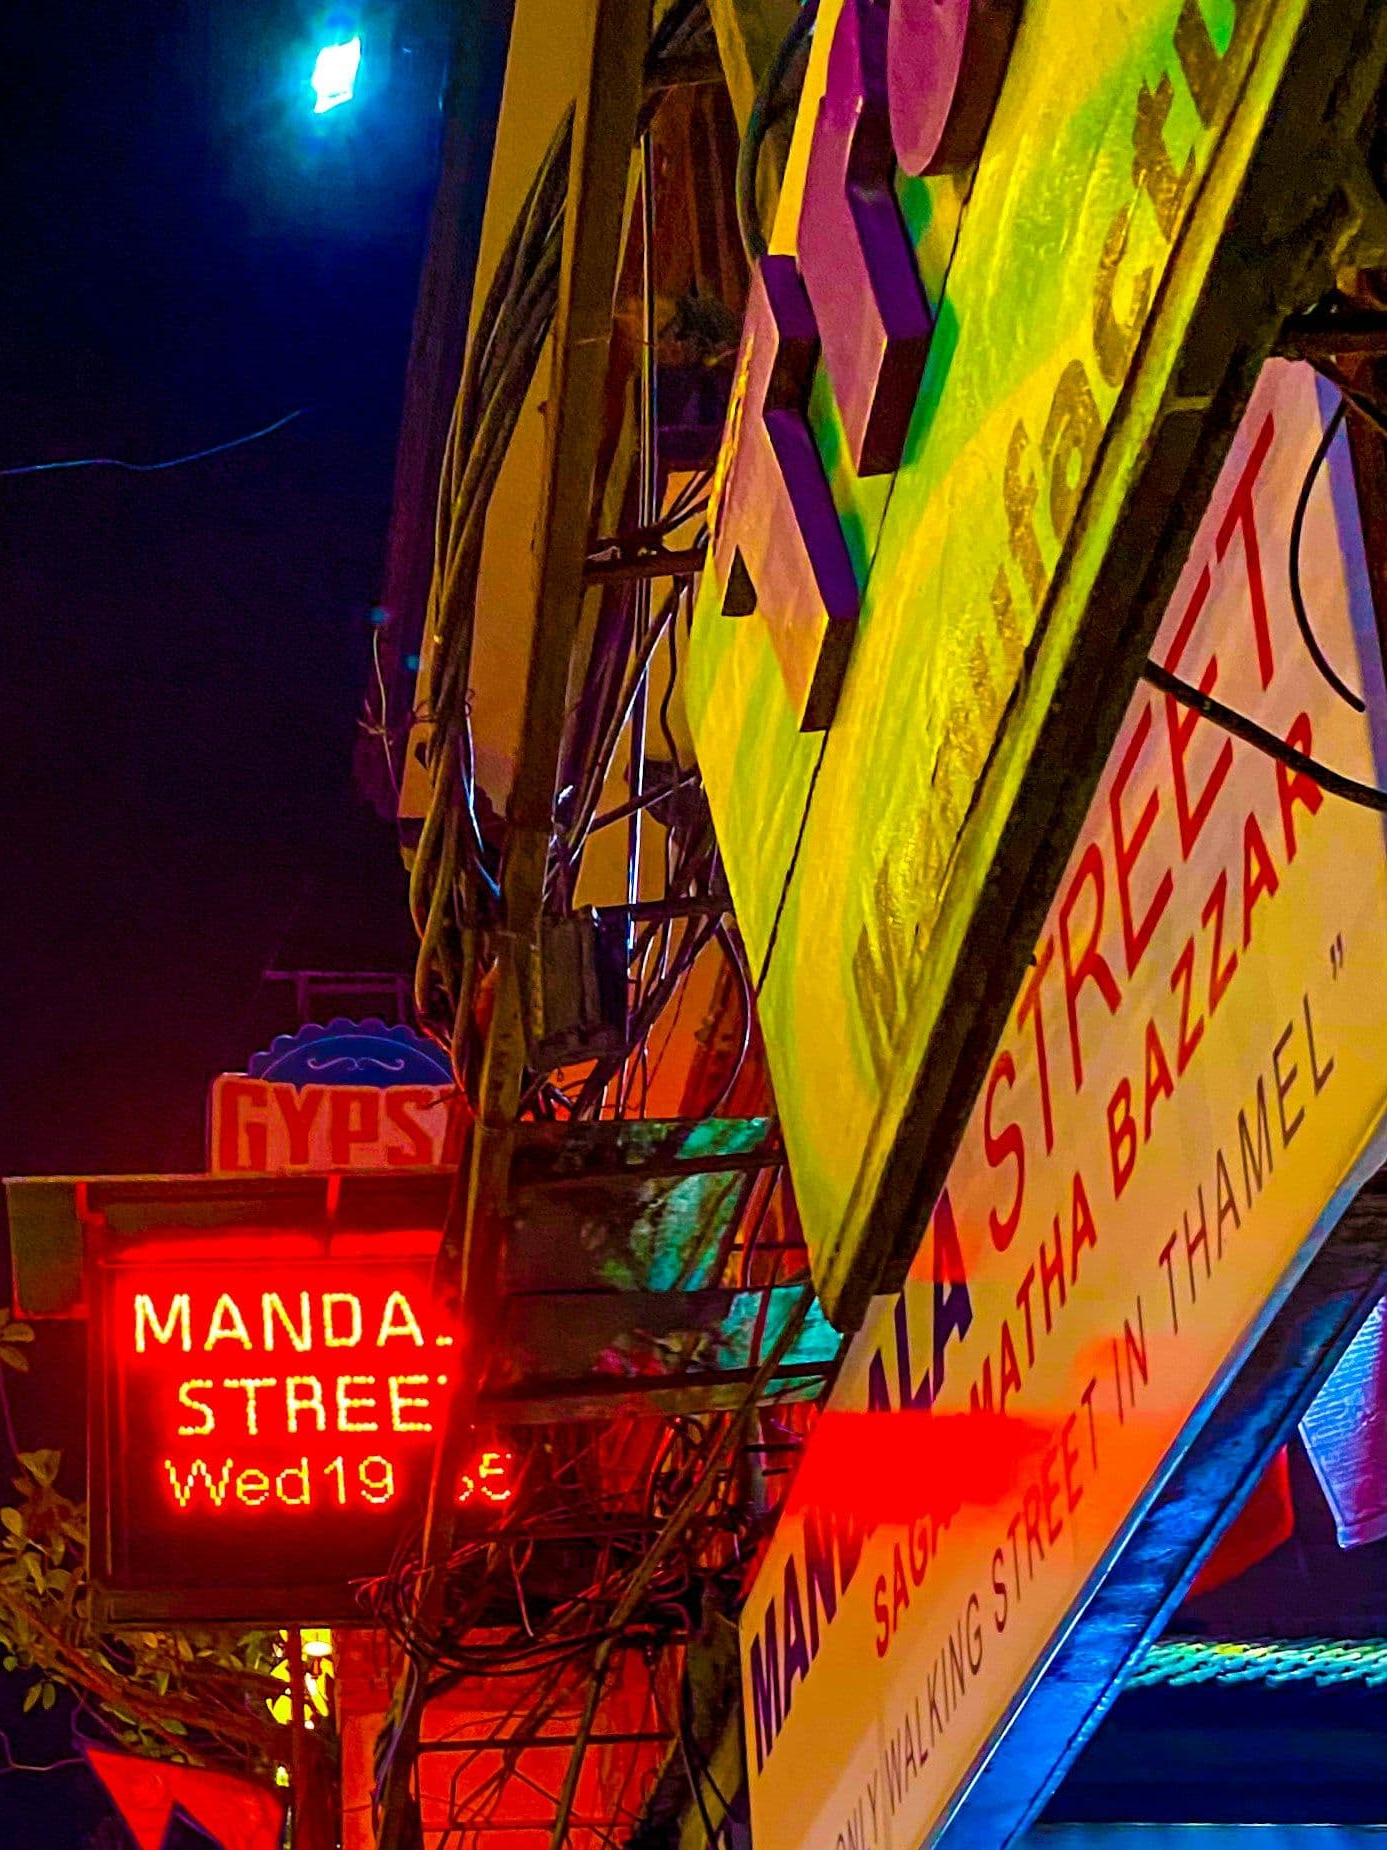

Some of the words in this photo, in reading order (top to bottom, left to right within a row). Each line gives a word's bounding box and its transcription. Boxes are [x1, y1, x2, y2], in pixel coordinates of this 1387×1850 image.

[983, 411, 1275, 1188] STREET
[1108, 711, 1325, 1173] BAZZAR
[134, 1291, 454, 1352] MANDA
[178, 1375, 447, 1436] STREE
[886, 1601, 983, 1816] WALKING
[992, 1378, 1099, 1634] STREET
[1119, 1319, 1150, 1423] IN
